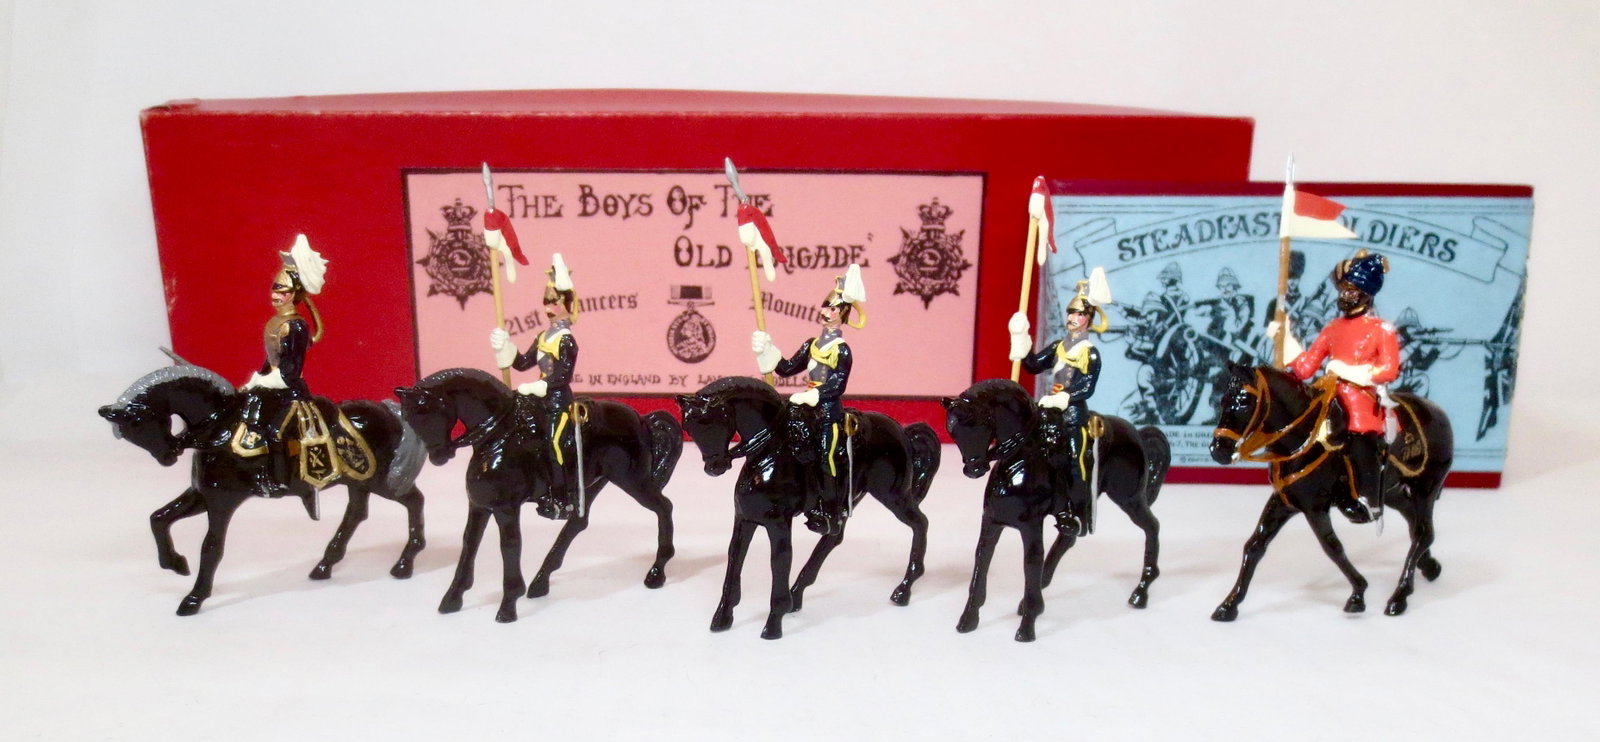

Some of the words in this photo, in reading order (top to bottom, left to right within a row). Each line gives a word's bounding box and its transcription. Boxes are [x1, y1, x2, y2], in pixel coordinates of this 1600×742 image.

[497, 184, 564, 219] THE
[577, 184, 654, 220] BOYS
[665, 184, 707, 230] OF
[673, 235, 733, 268] OLD
[1341, 213, 1459, 263] LDIERS
[503, 309, 542, 336] 21st
[577, 292, 638, 313] ancers
[588, 374, 603, 386] IN
[607, 373, 662, 386] ENGLAND
[669, 373, 689, 388] BY
